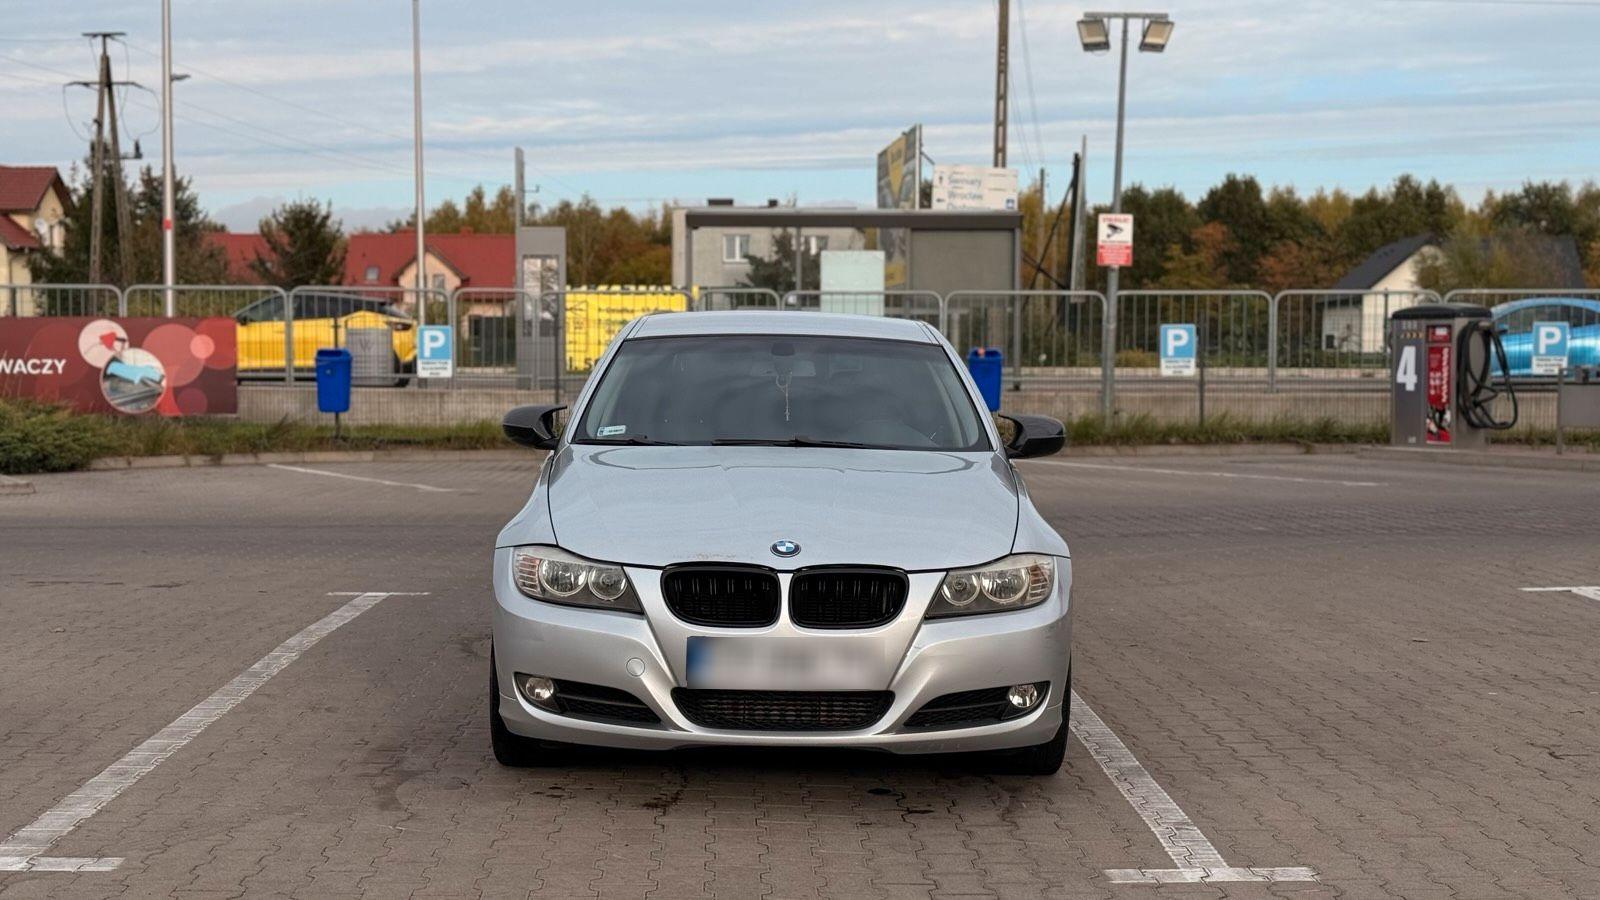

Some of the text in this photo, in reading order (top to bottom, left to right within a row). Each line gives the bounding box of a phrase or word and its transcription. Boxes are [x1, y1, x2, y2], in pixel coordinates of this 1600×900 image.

[424, 330, 446, 358] P
[1167, 329, 1189, 356] P
[1539, 326, 1561, 354] P
[1396, 345, 1418, 391] 4
